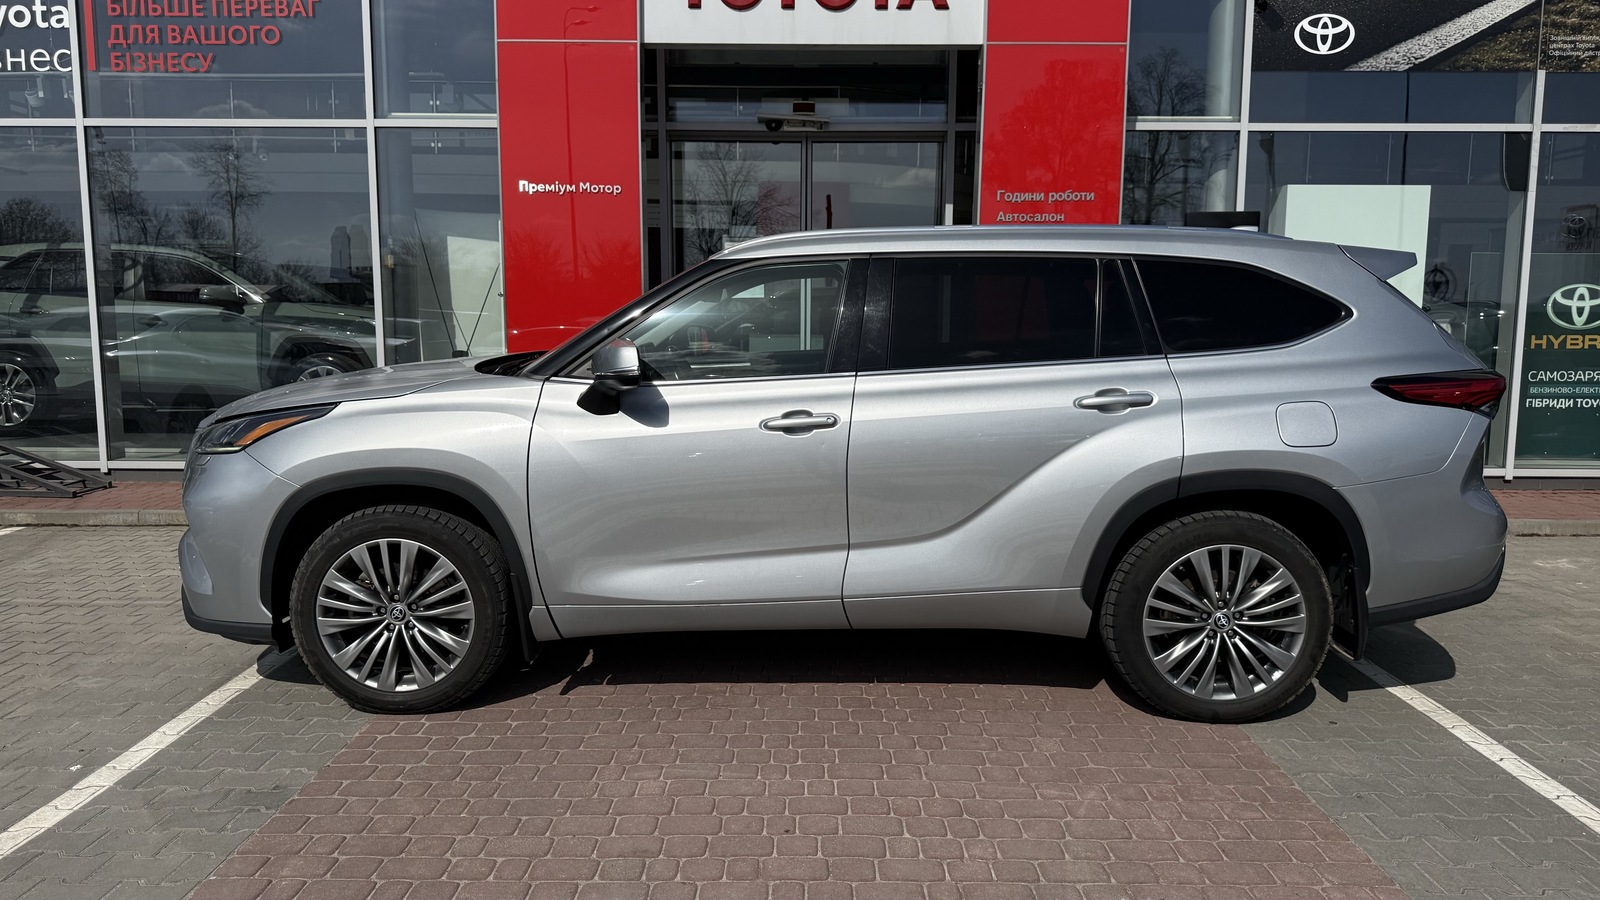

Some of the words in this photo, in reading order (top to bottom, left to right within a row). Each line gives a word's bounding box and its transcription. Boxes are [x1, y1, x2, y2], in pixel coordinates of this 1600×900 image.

[0, 0, 69, 28] ota
[107, 0, 204, 17] БІЛЬШЕ
[212, 0, 319, 17] ПЕРЕВАГ
[108, 25, 159, 48] ДЛЯ
[167, 25, 280, 45] ВАШОГО
[0, 49, 72, 72] нес
[110, 52, 213, 73] БІЗНЕСУ
[518, 180, 576, 195] Преміум
[579, 182, 622, 196] Мотор
[996, 190, 1045, 203] Години
[1048, 190, 1095, 204] роботи
[996, 211, 1065, 222] Автосалон
[1530, 334, 1600, 349] HYBR
[1528, 370, 1600, 382] САМОЗАРЯ
[1526, 398, 1574, 409] ГІБРИДИ
[1576, 398, 1600, 408] TOY
